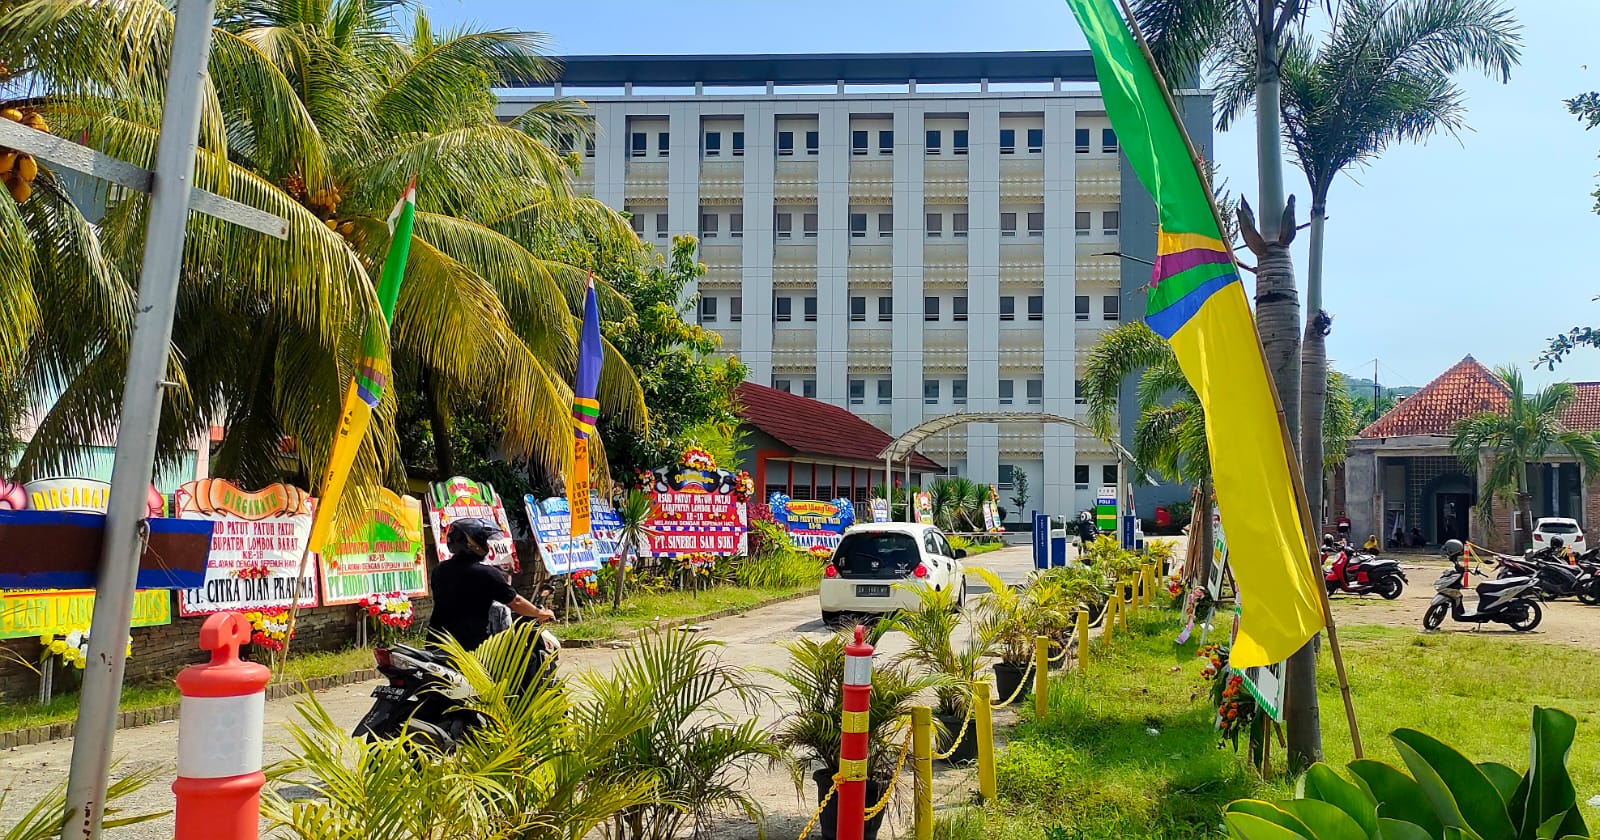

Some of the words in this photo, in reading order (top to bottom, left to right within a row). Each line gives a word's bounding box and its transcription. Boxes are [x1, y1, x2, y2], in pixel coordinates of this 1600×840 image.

[210, 537, 244, 550] BUPATEN
[208, 578, 240, 603] CITRA
[246, 577, 270, 602] DIAN
[274, 576, 314, 600] PRATMA
